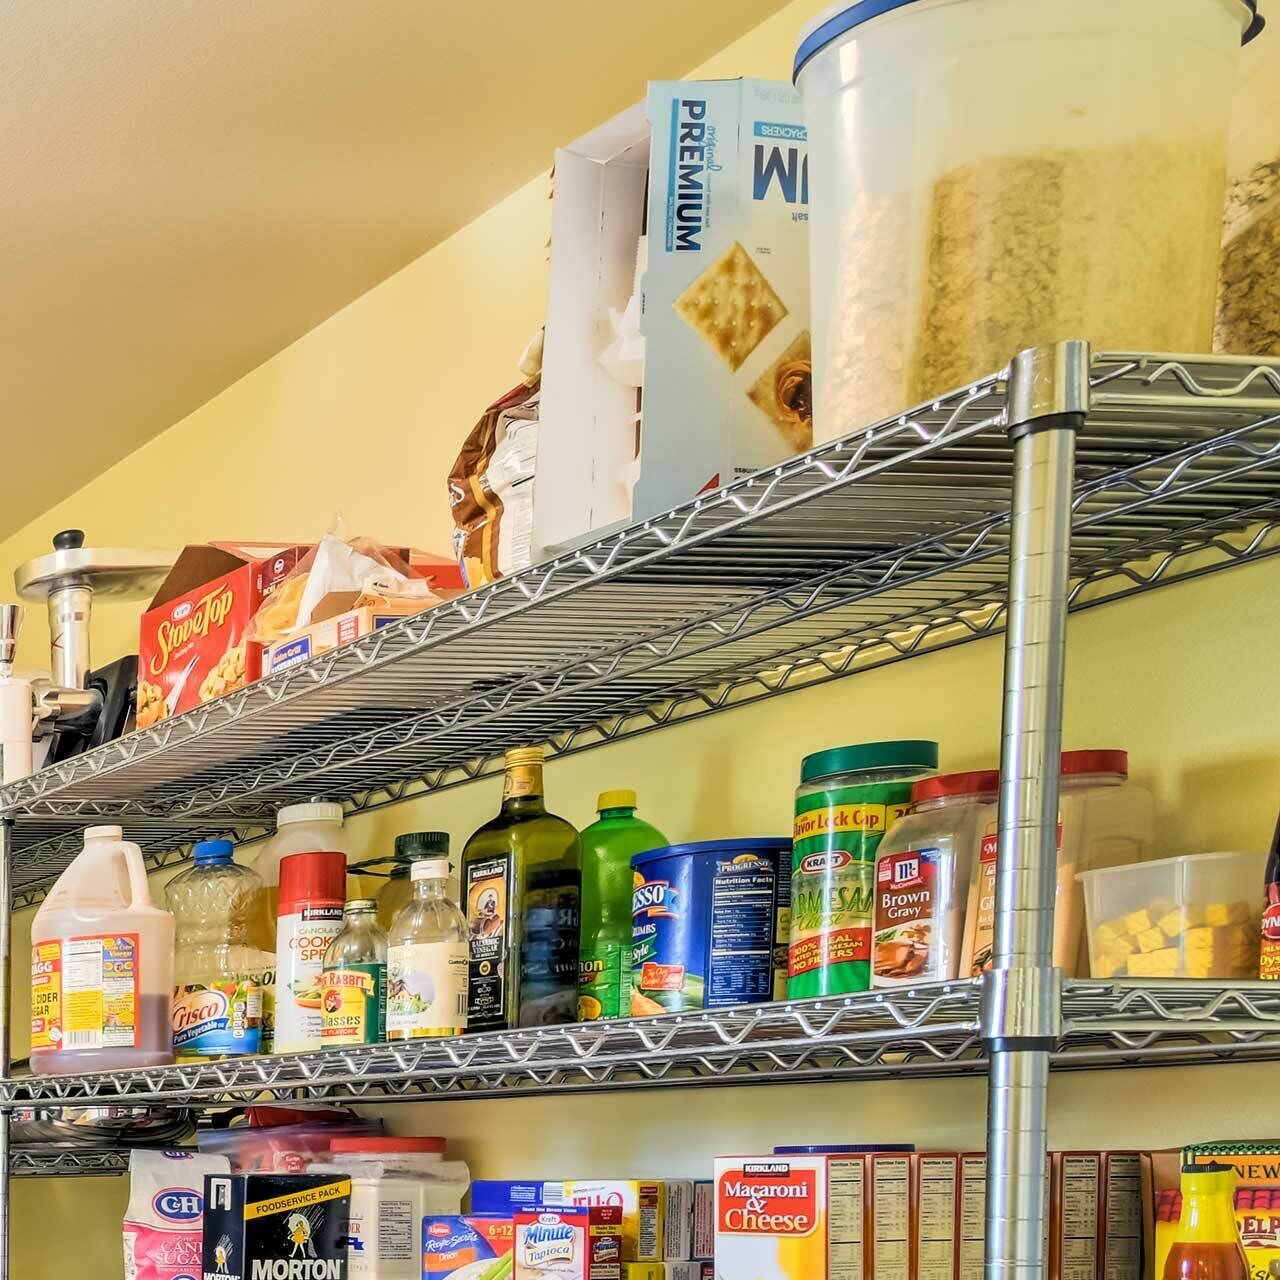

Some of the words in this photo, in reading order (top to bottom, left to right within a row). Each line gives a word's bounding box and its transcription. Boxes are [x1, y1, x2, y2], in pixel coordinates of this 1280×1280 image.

[676, 100, 706, 251] PREMIUM
[853, 810, 879, 830] Cap
[473, 867, 503, 877] KIRKLAND
[722, 860, 769, 873] PROGRESSO
[715, 877, 749, 886] Nutrition
[752, 876, 773, 884] Facts
[882, 891, 929, 907] Brown
[888, 906, 921, 918] Gravy
[330, 973, 366, 986] RABBIT
[746, 1164, 788, 1172] KIRKLAND
[725, 1182, 808, 1198] Macaroni
[257, 1194, 316, 1213] FOODSERVICE
[318, 1187, 341, 1200] PACK
[746, 1195, 766, 1212] &
[725, 1209, 808, 1231] Cheese
[524, 1226, 573, 1244] Minute
[529, 1244, 570, 1262] Tapioca
[252, 1260, 340, 1280] MORTON
